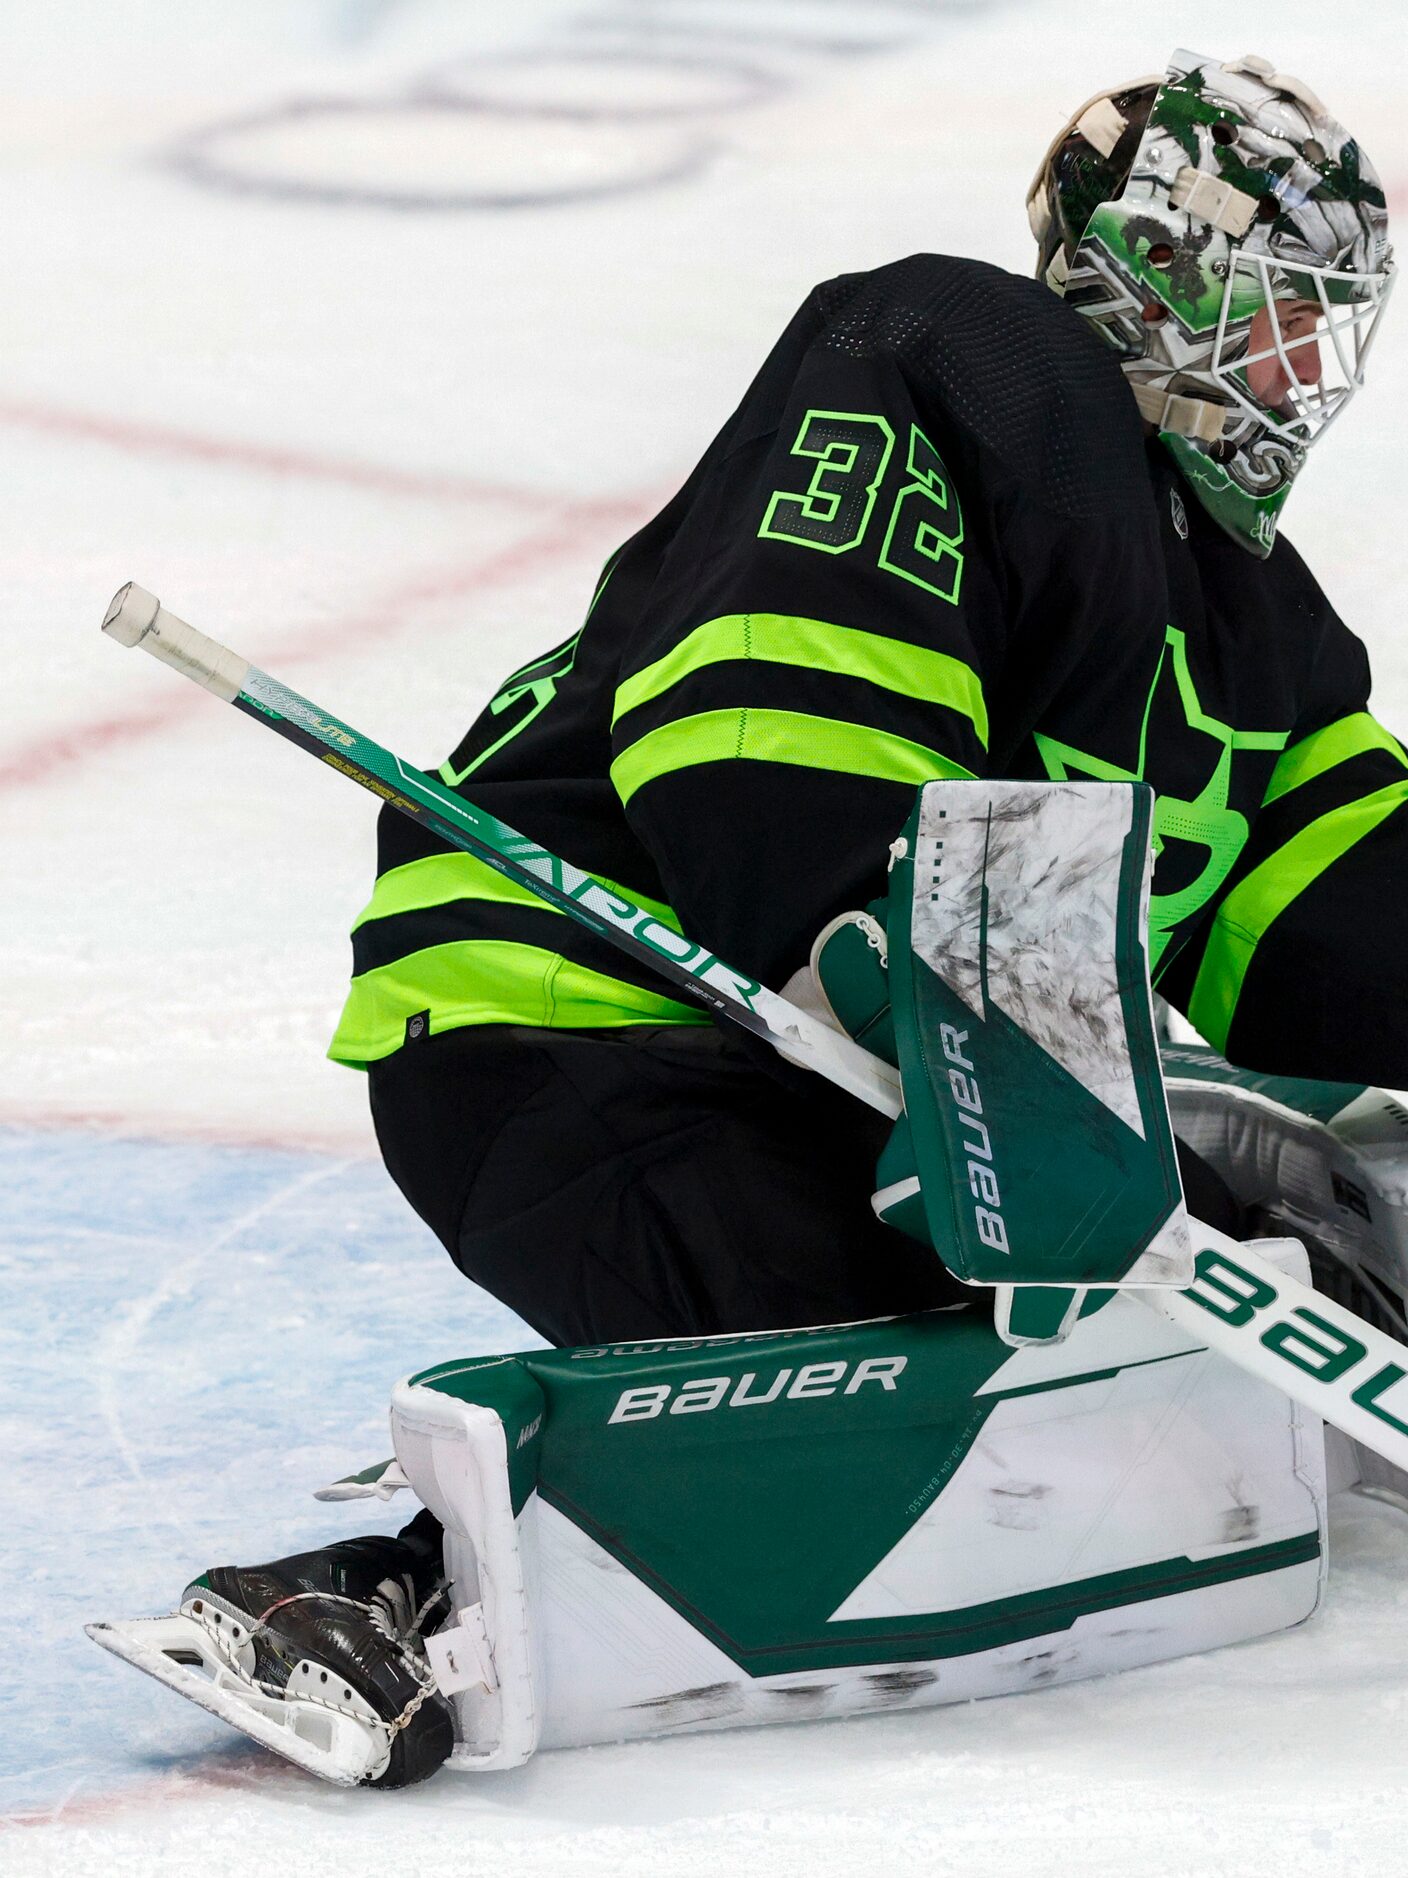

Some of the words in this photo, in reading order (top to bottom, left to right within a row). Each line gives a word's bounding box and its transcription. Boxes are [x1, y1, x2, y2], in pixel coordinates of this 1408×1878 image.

[757, 409, 965, 606] 32
[939, 1022, 1010, 1256] BAUER
[607, 1355, 908, 1425] BAUER
